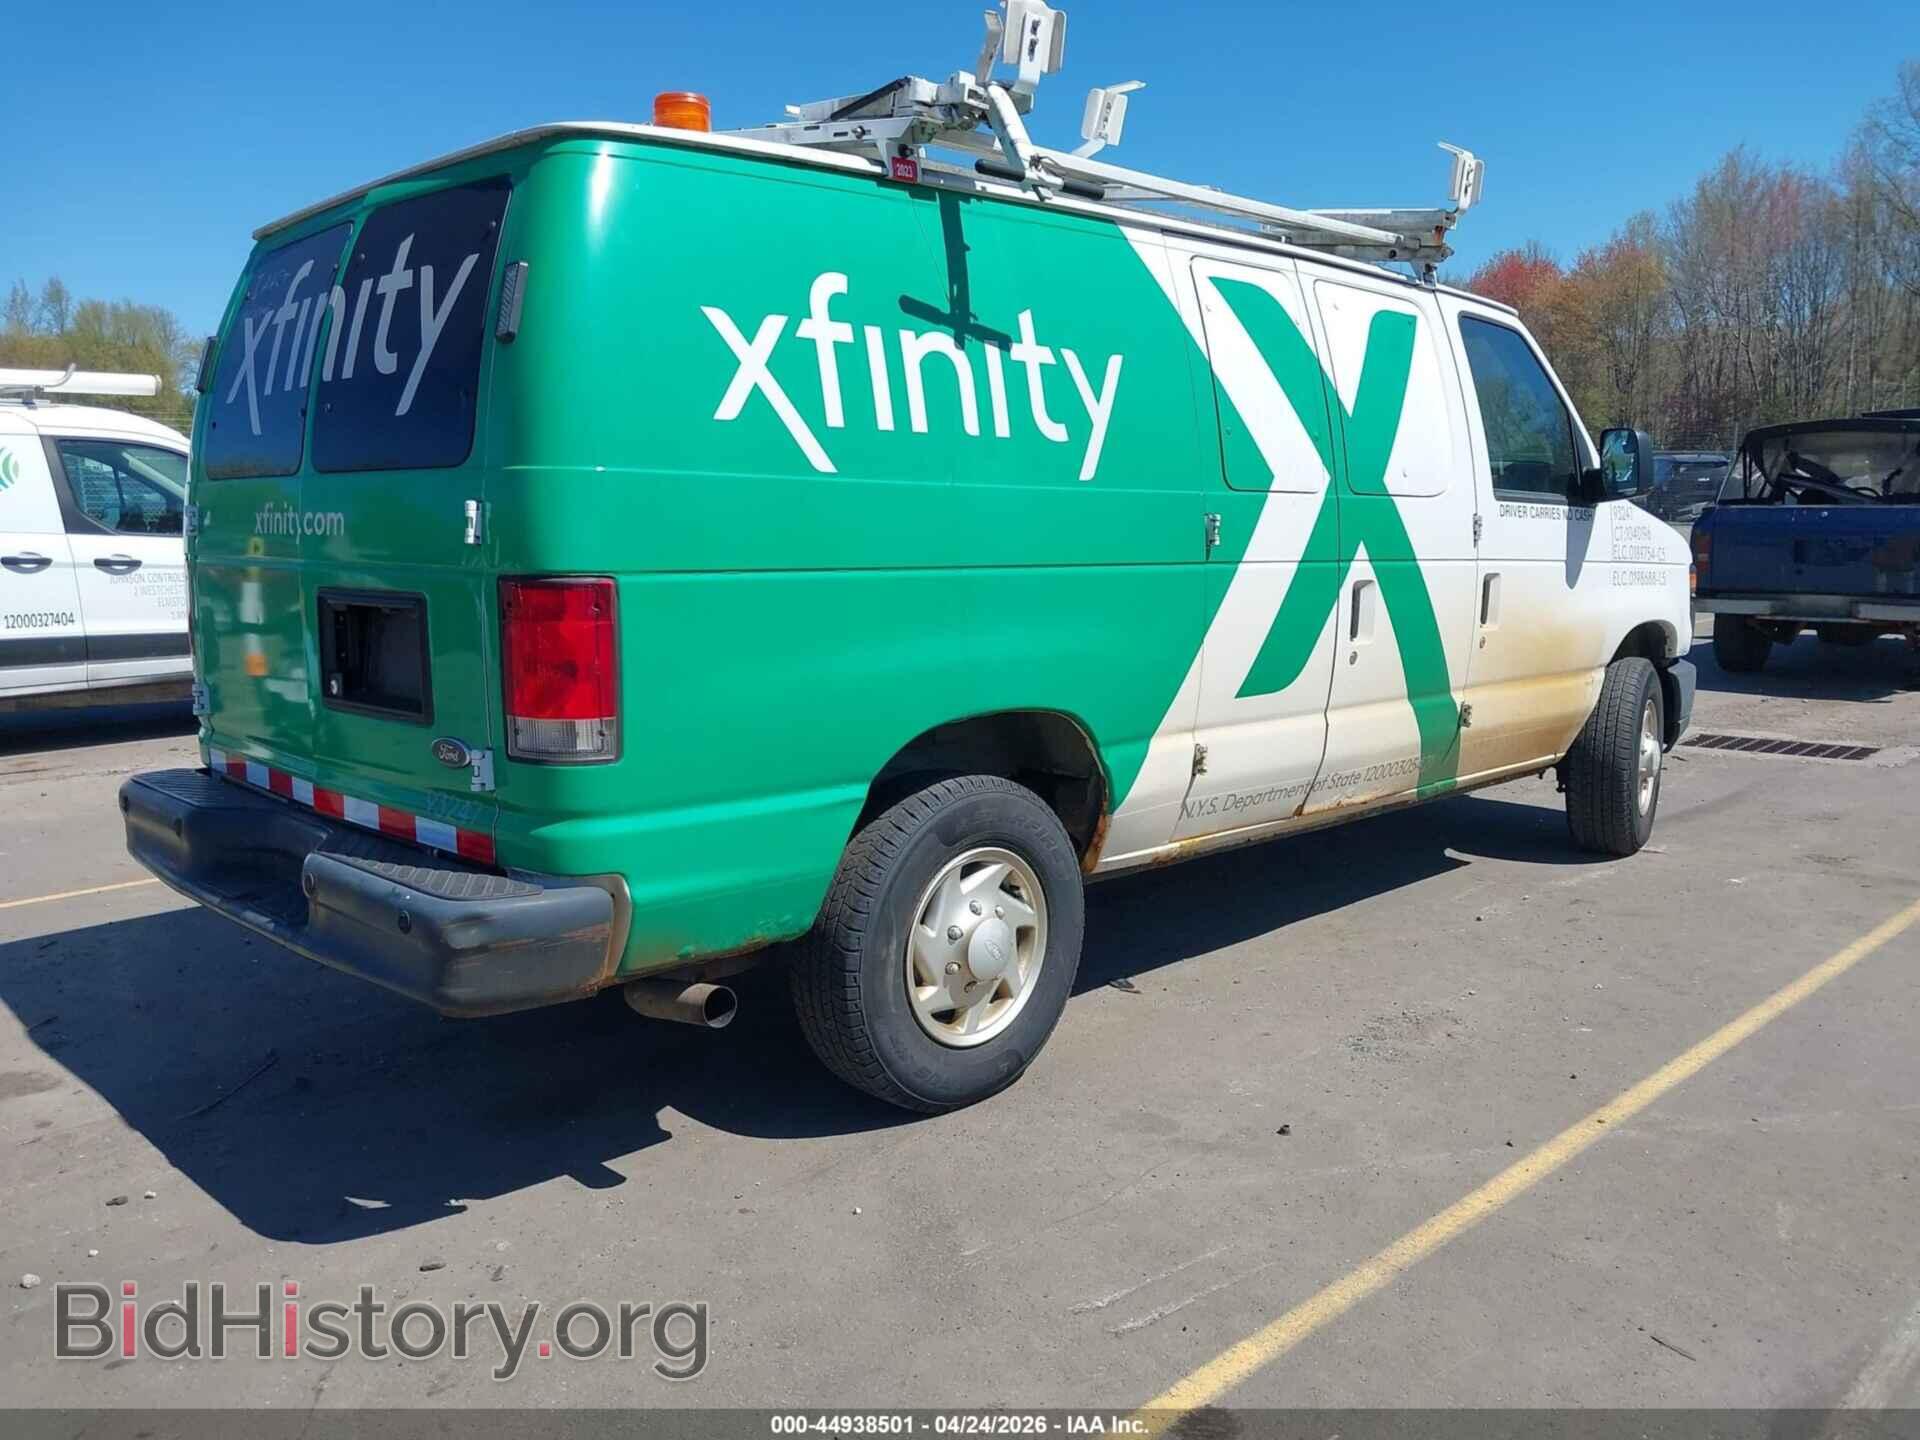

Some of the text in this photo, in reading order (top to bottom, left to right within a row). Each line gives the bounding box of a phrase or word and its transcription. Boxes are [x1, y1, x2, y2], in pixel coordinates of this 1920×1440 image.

[226, 233, 480, 436] xfinity
[700, 271, 1124, 481] xfinity
[255, 501, 345, 545] xfinity.com
[1499, 503, 1593, 522] DRIVER CARRIES NO CASH
[4, 611, 75, 629] 12000327404
[1222, 782, 1312, 813] Department
[1327, 769, 1361, 789] State
